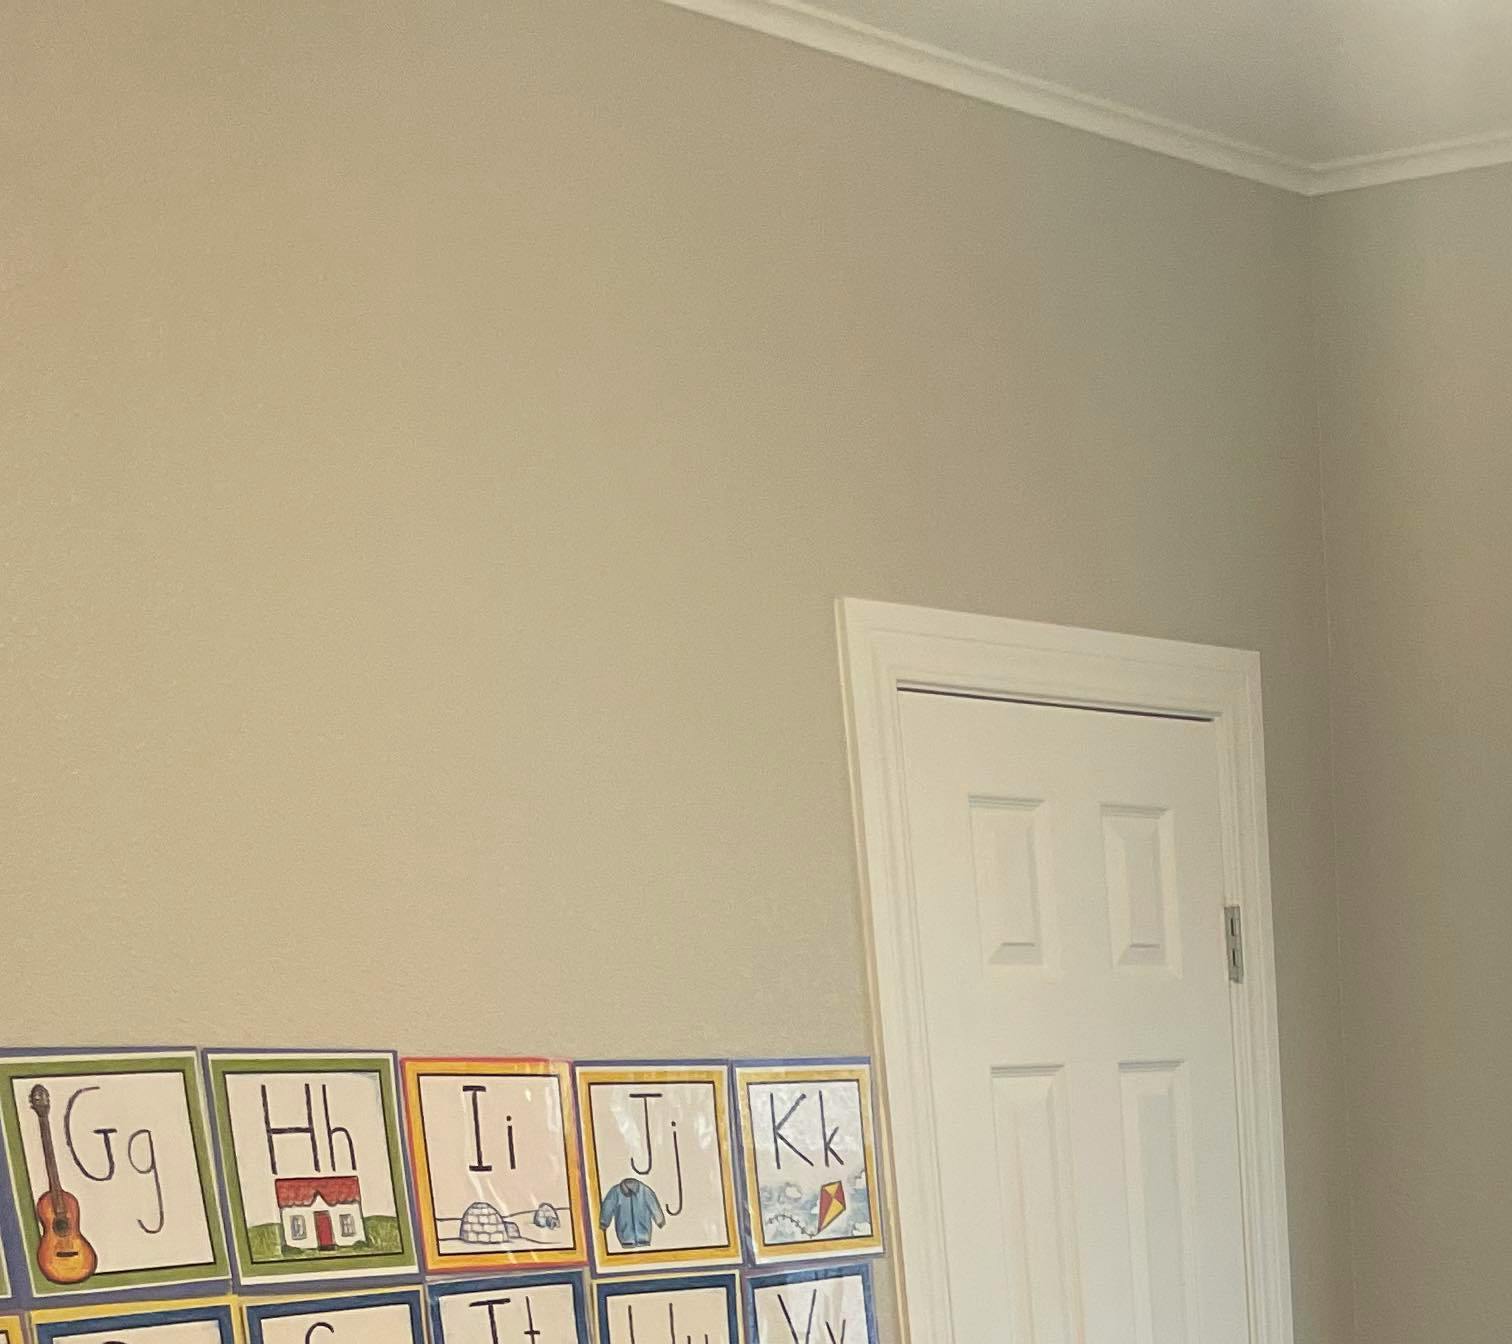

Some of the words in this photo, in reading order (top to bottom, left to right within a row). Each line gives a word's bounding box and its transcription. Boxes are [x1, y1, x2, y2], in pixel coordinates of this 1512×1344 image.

[64, 1086, 164, 1234] Gg
[261, 1083, 357, 1175] Hh
[463, 1085, 516, 1172] Ii
[629, 1093, 683, 1216] Jj
[769, 1090, 844, 1170] Kk
